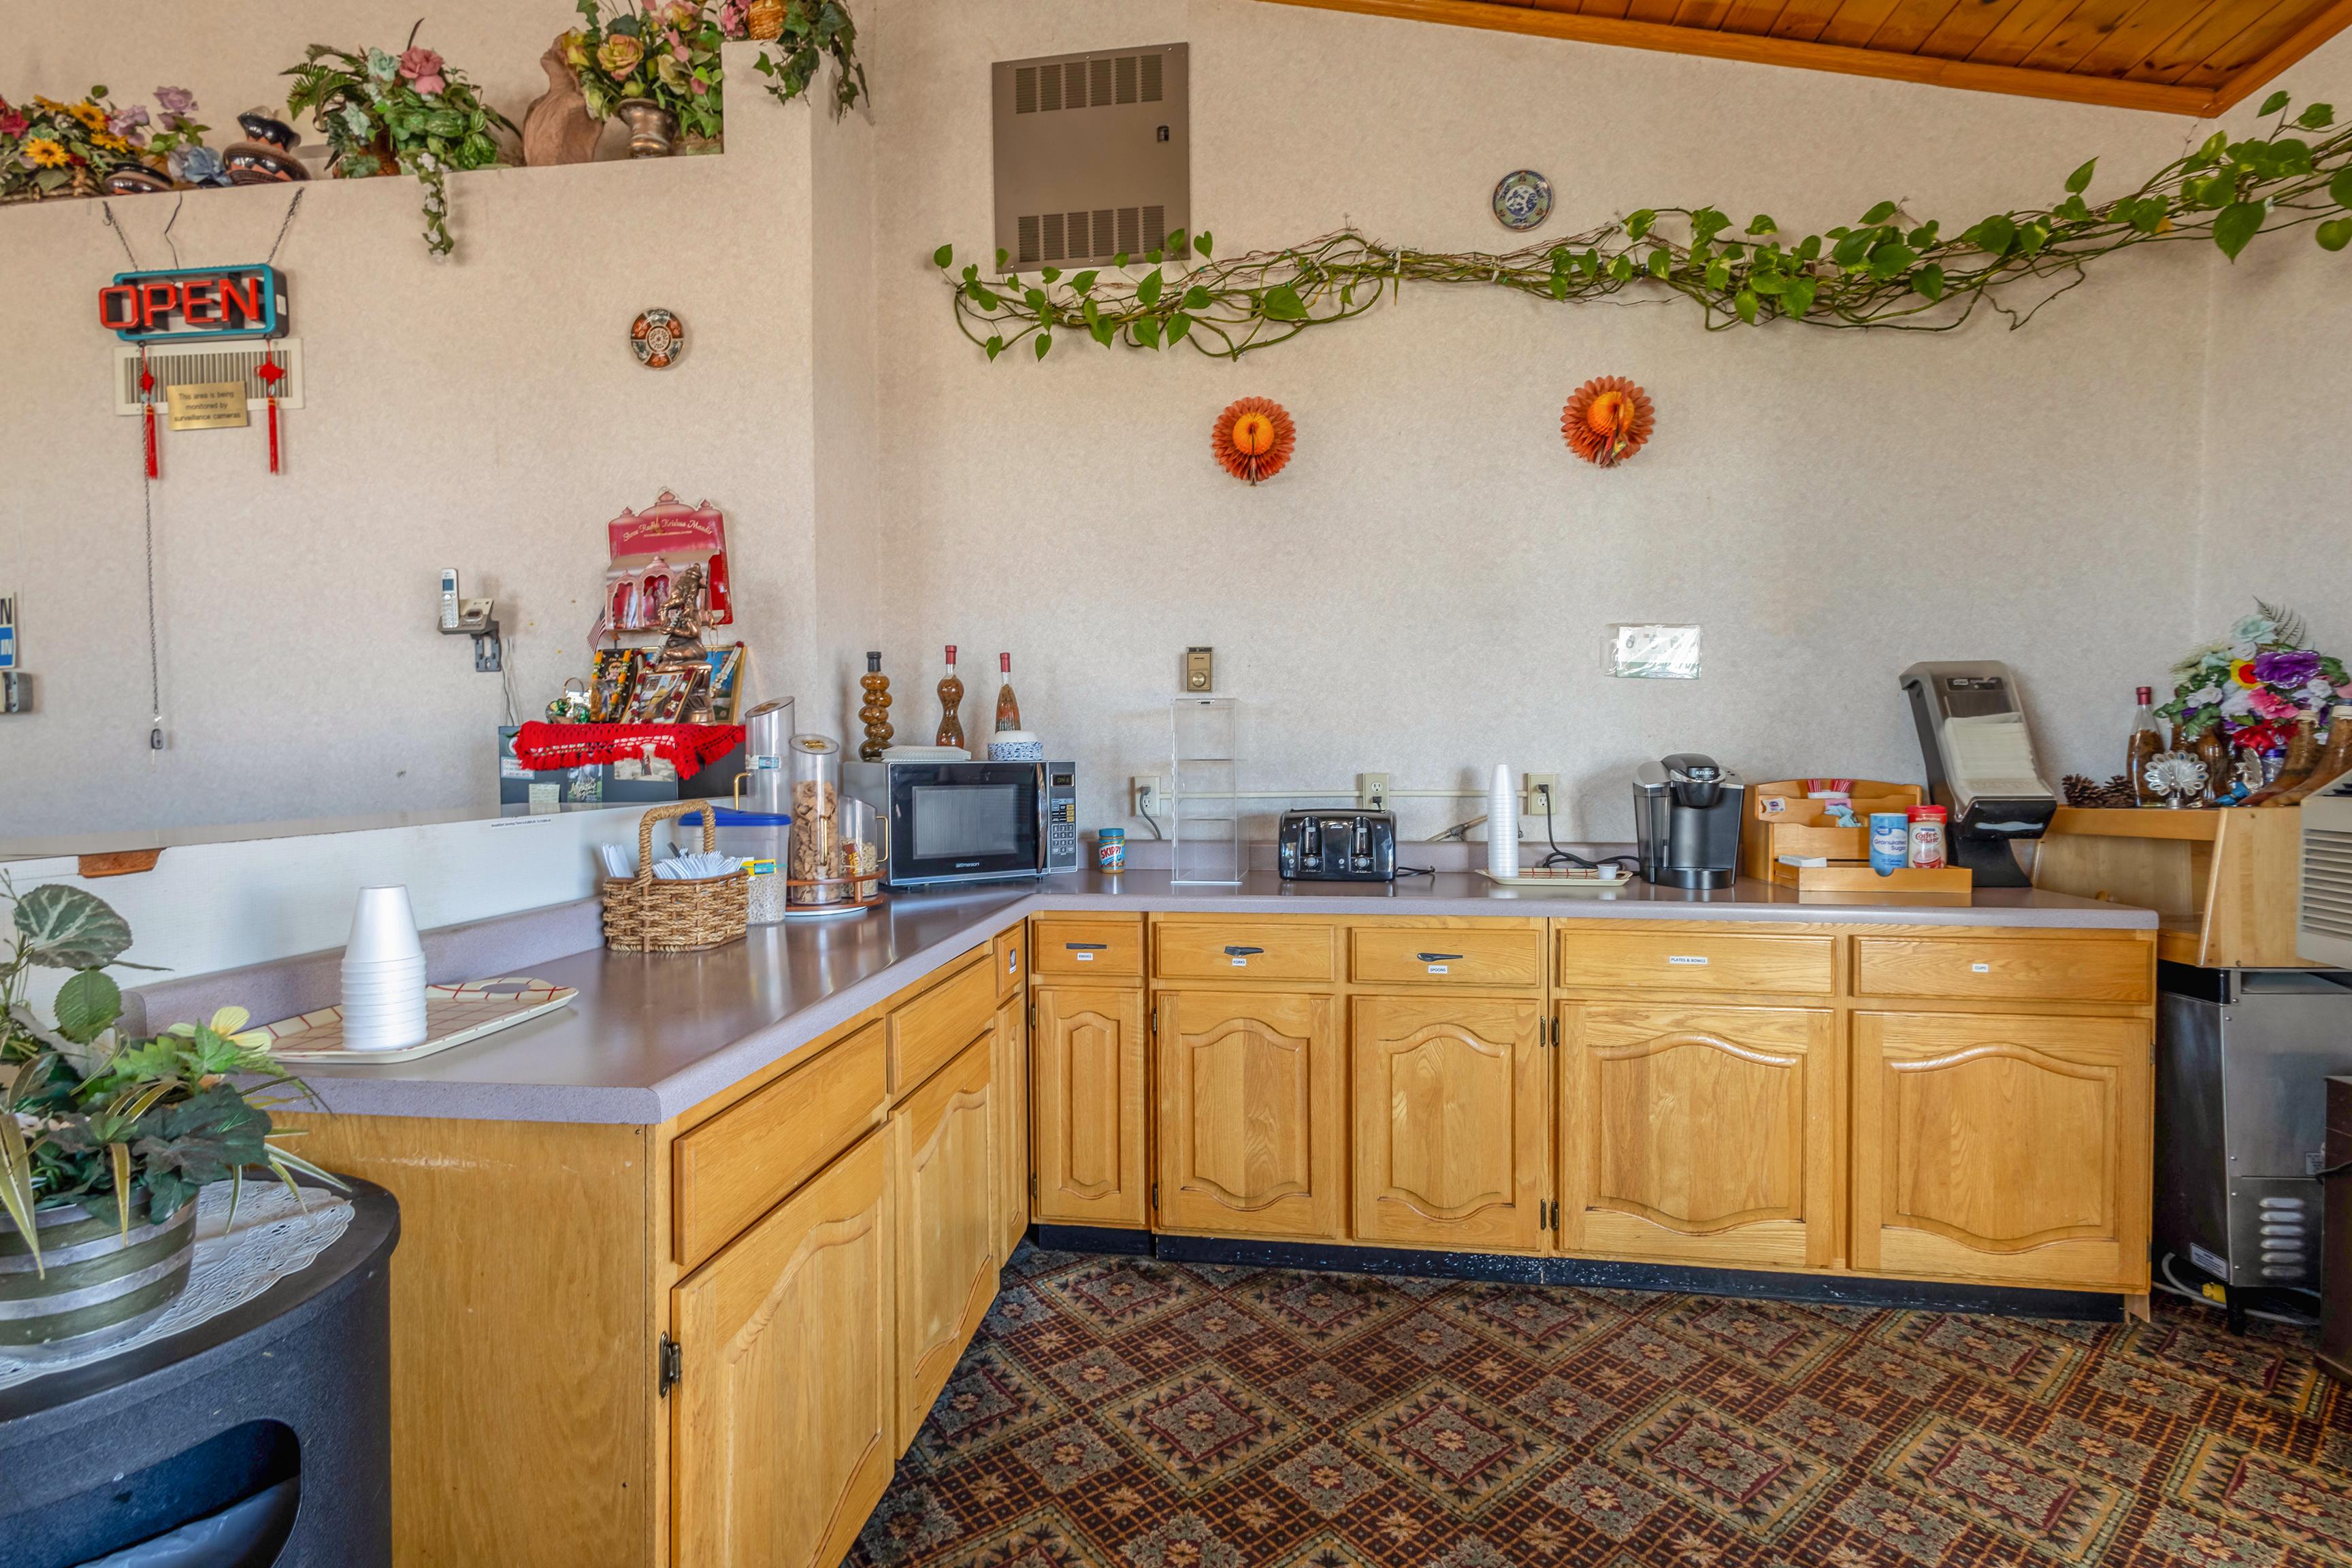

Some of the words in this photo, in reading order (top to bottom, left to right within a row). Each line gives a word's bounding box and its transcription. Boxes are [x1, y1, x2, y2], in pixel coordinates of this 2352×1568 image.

[99, 277, 259, 329] OPEN
[174, 413, 211, 421] surveillance
[1915, 832, 1938, 840] Coffee
[1100, 845, 1122, 859] SKIPPY
